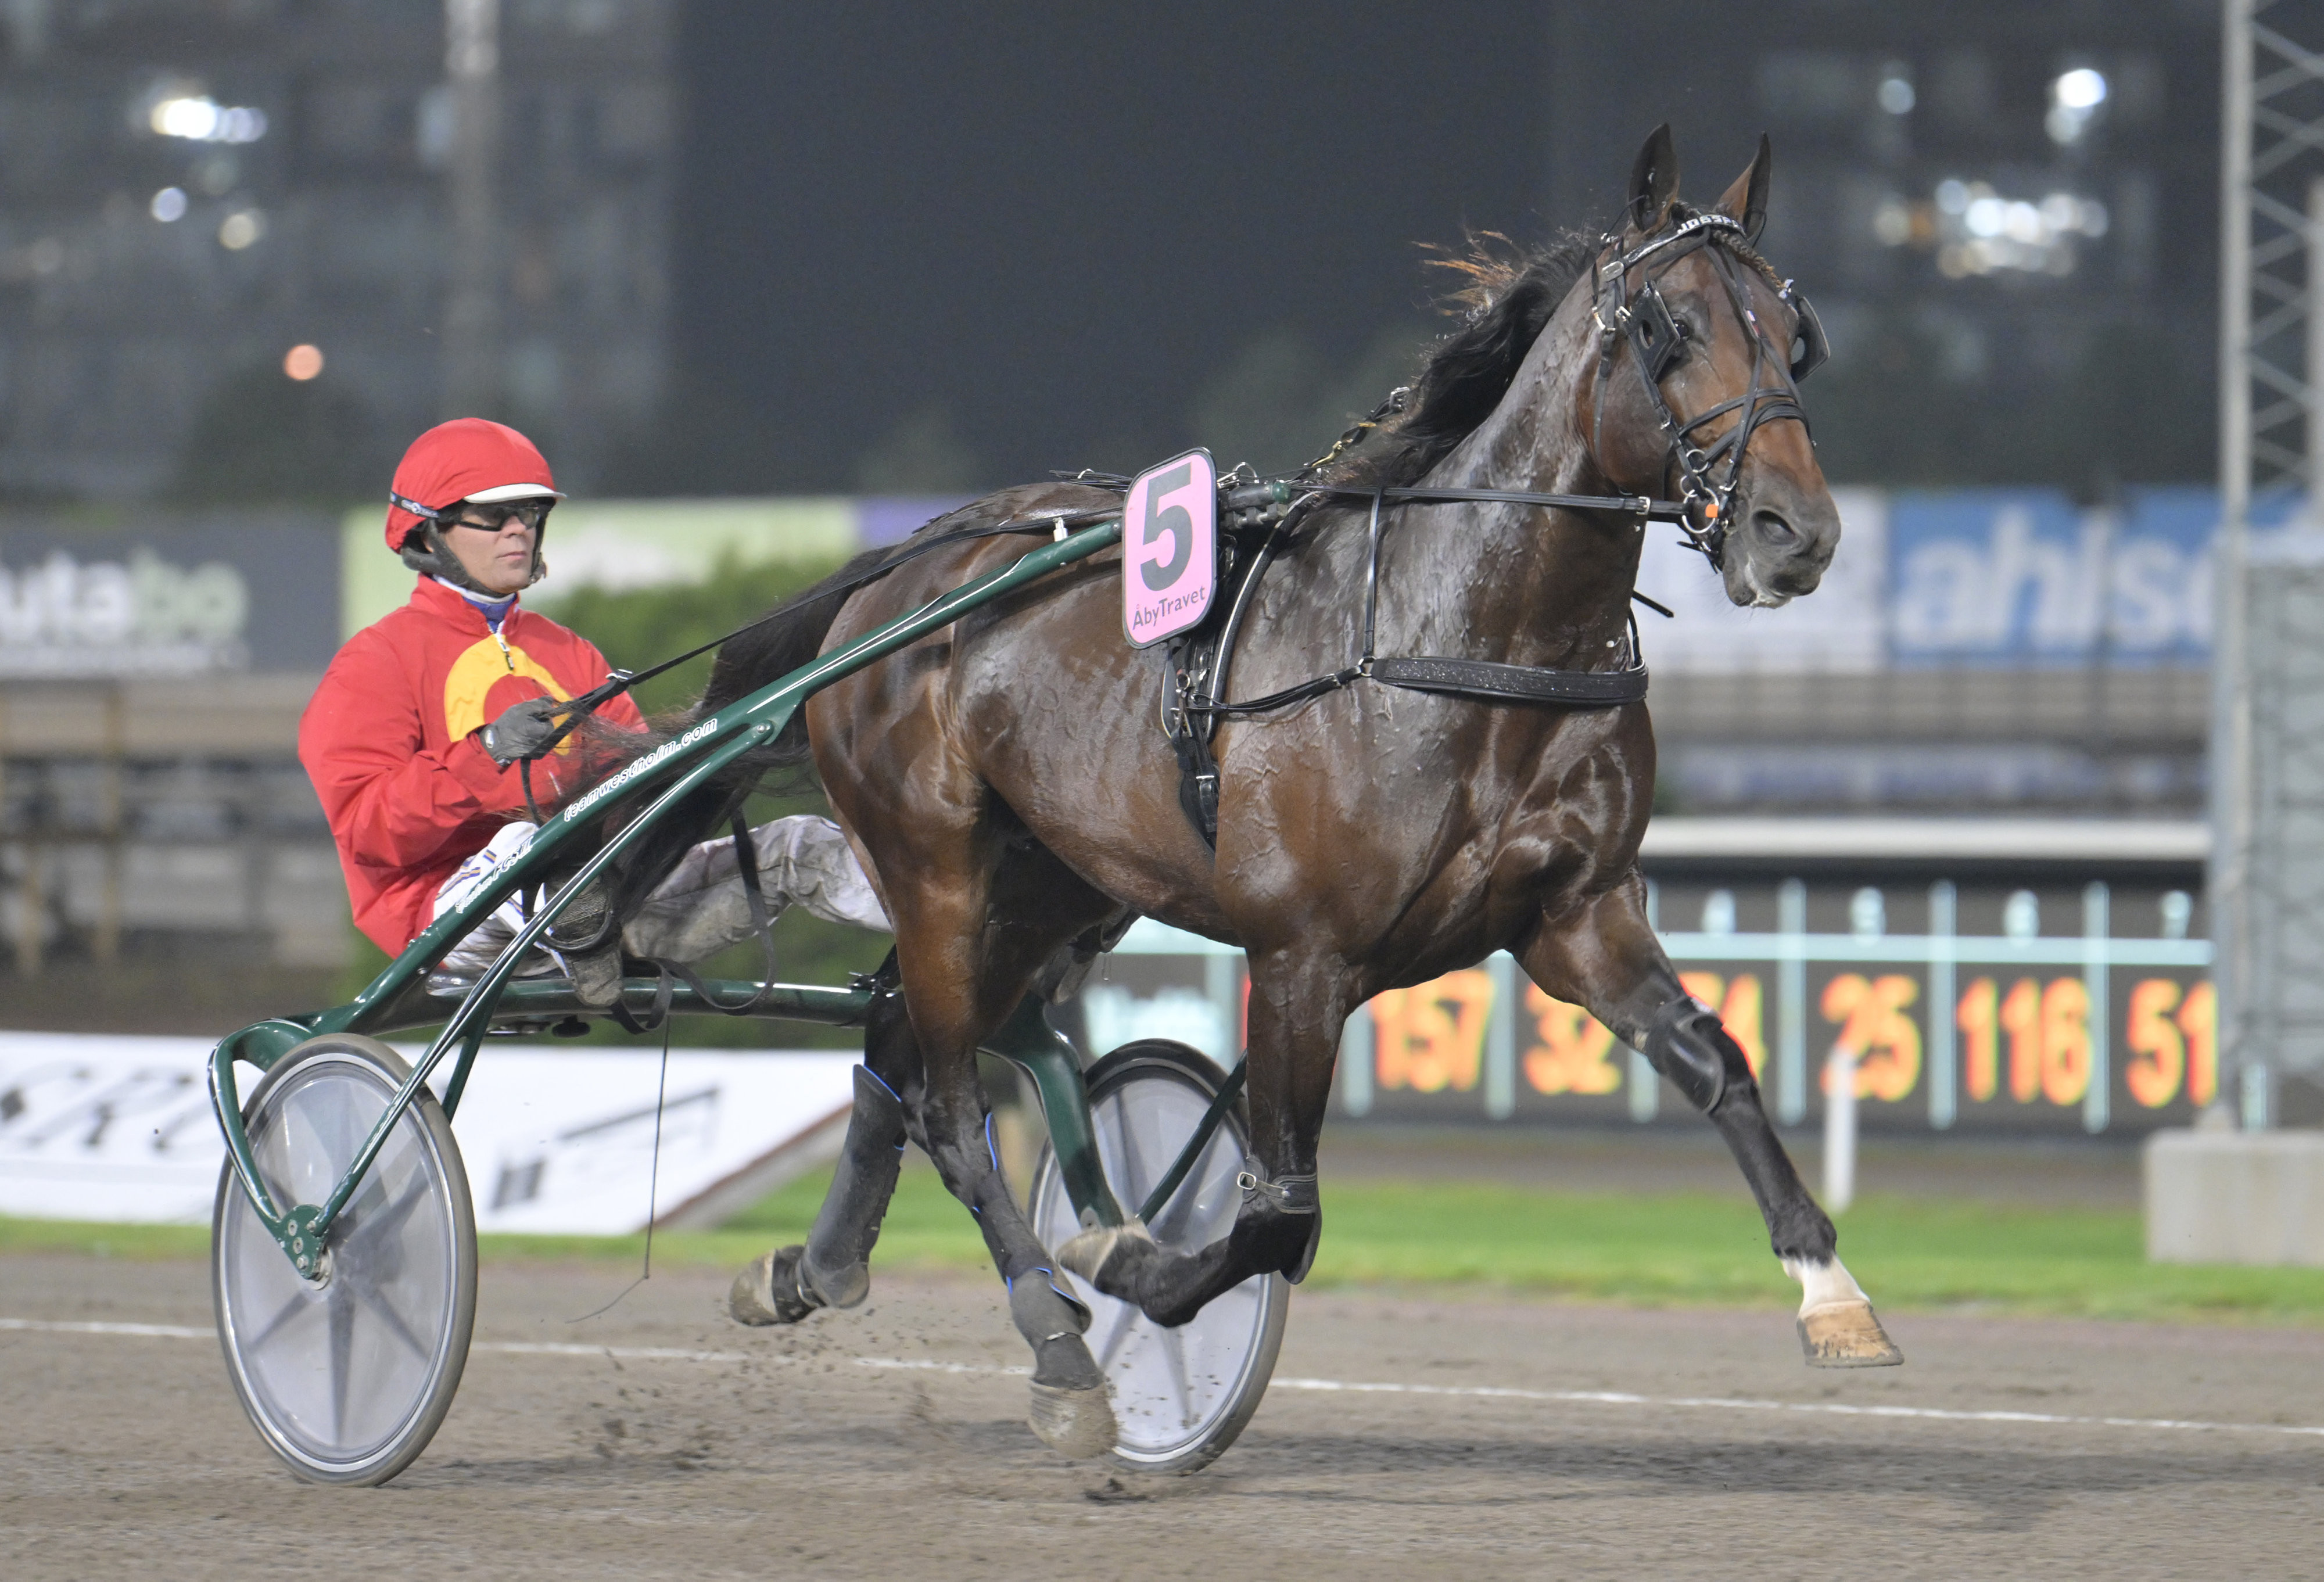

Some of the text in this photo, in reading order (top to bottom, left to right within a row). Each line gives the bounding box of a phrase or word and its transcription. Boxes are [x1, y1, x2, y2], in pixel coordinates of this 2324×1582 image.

[1140, 462, 1192, 591] 5
[1132, 585, 1206, 630] ÅbyTravet
[564, 718, 718, 822] teamwestholm.com
[1956, 976, 2092, 1106] 116
[2126, 978, 2218, 1108] 51
